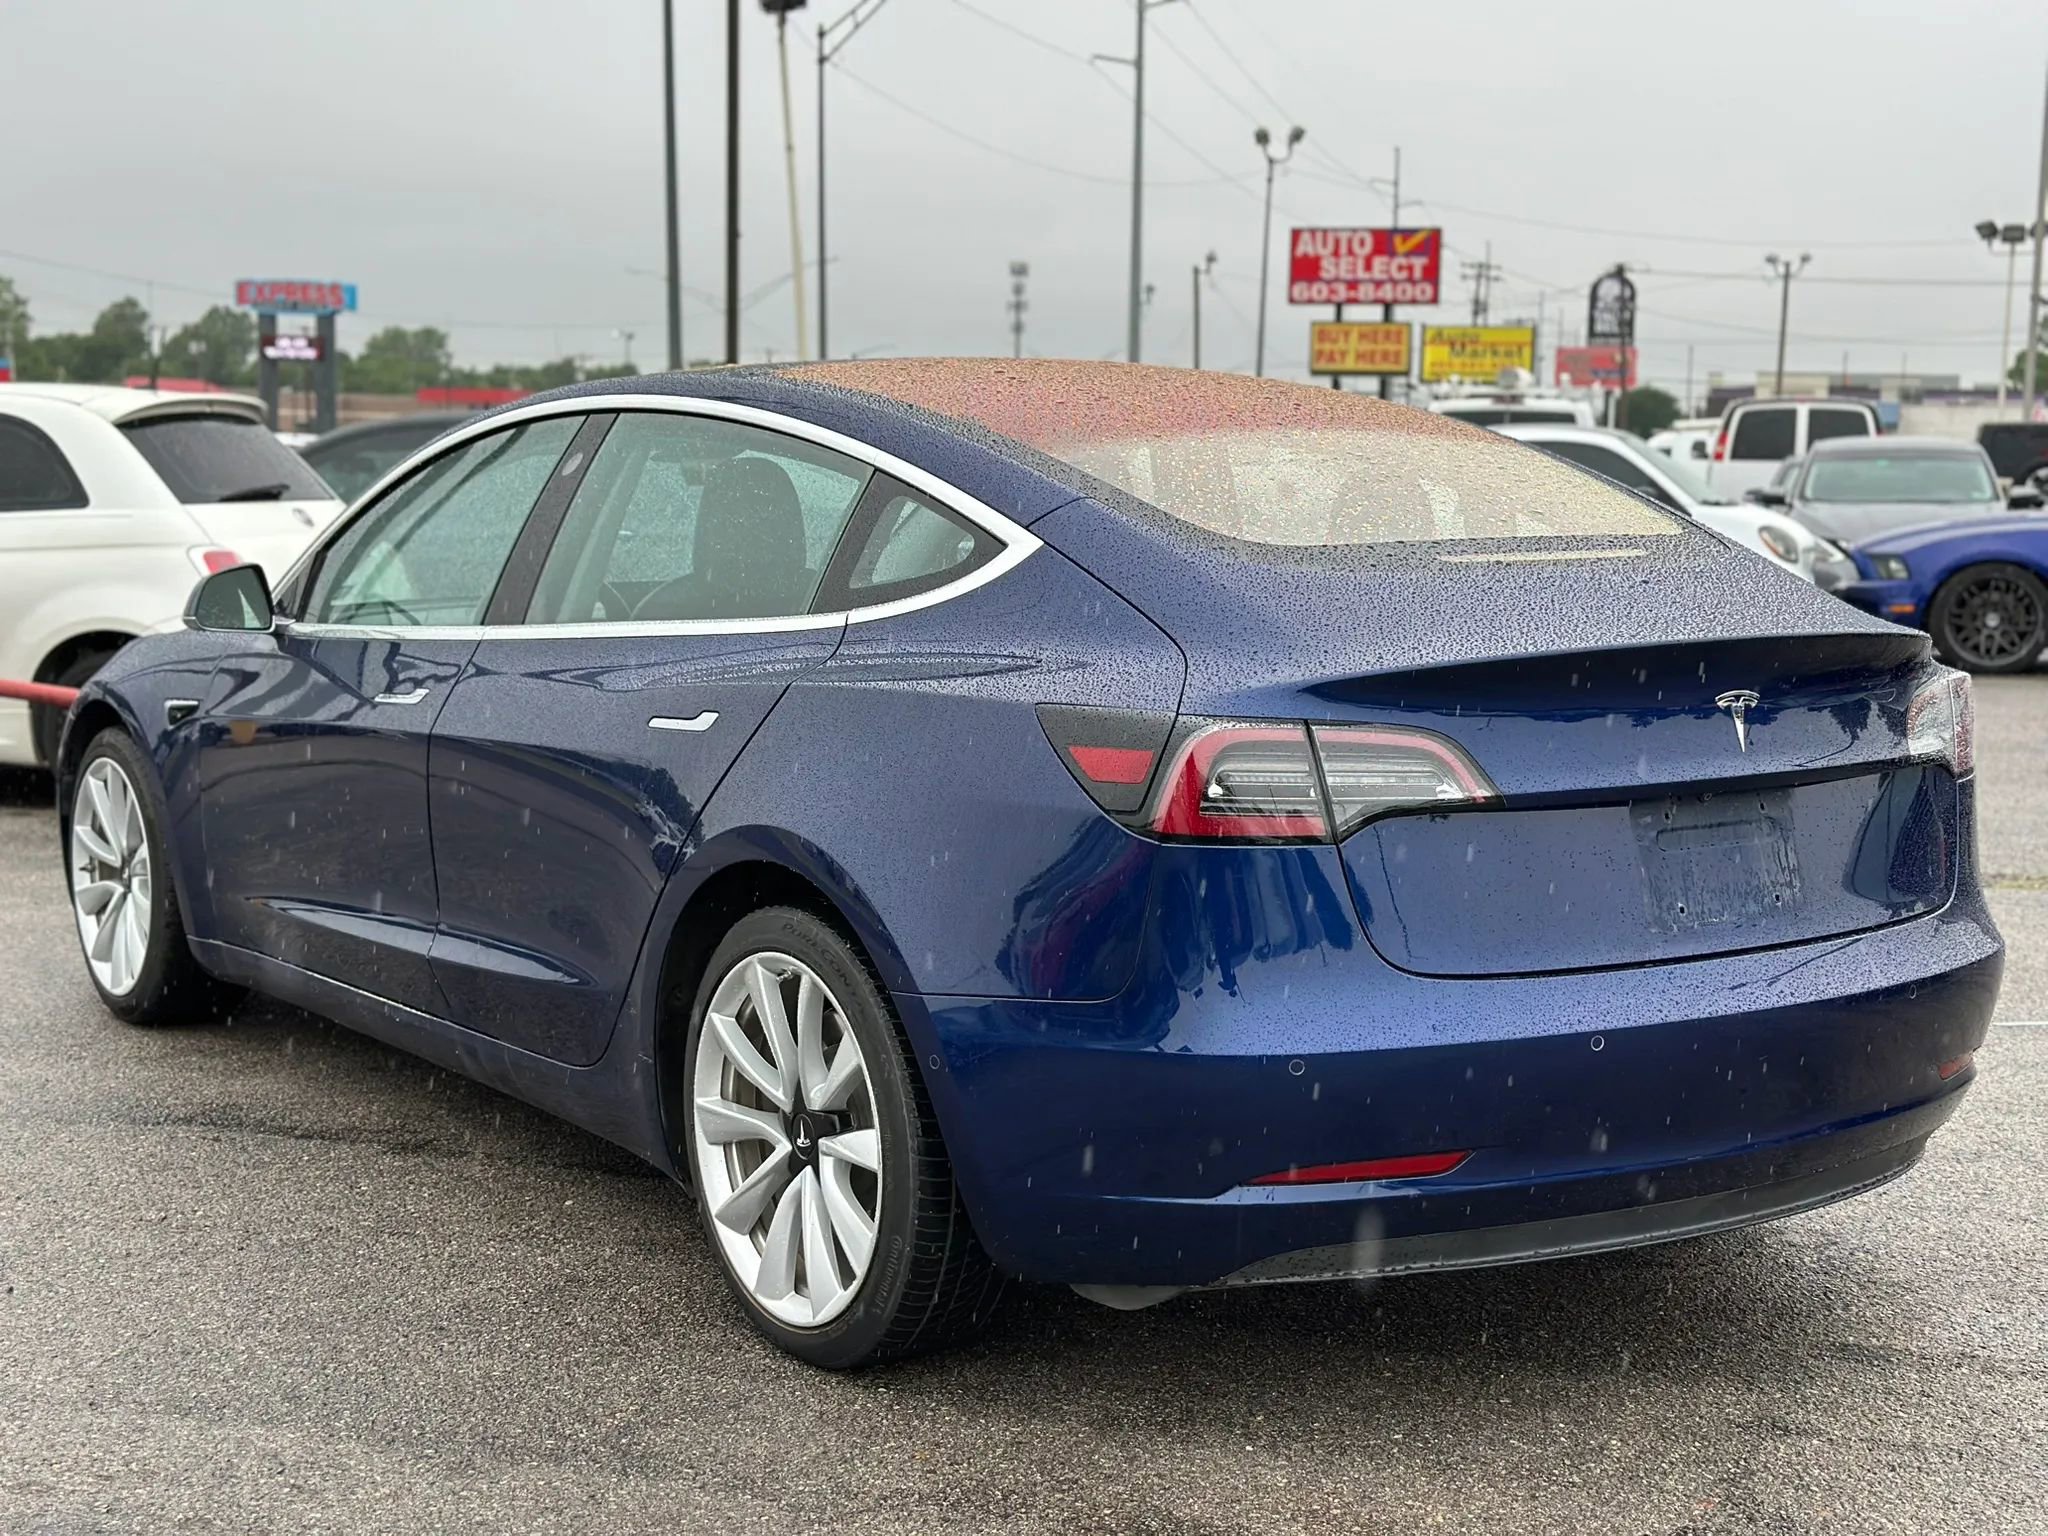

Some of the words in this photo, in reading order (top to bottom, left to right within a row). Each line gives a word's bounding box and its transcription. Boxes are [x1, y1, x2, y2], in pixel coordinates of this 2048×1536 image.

[1295, 231, 1374, 257] AUTO
[1319, 255, 1429, 280] SELECT
[236, 281, 345, 310] EXPRESS
[1291, 281, 1434, 303] 603-8400
[1316, 328, 1350, 345] BUY
[1358, 328, 1403, 345] HERE
[1316, 349, 1349, 366] PAY
[1357, 349, 1402, 367] HERE
